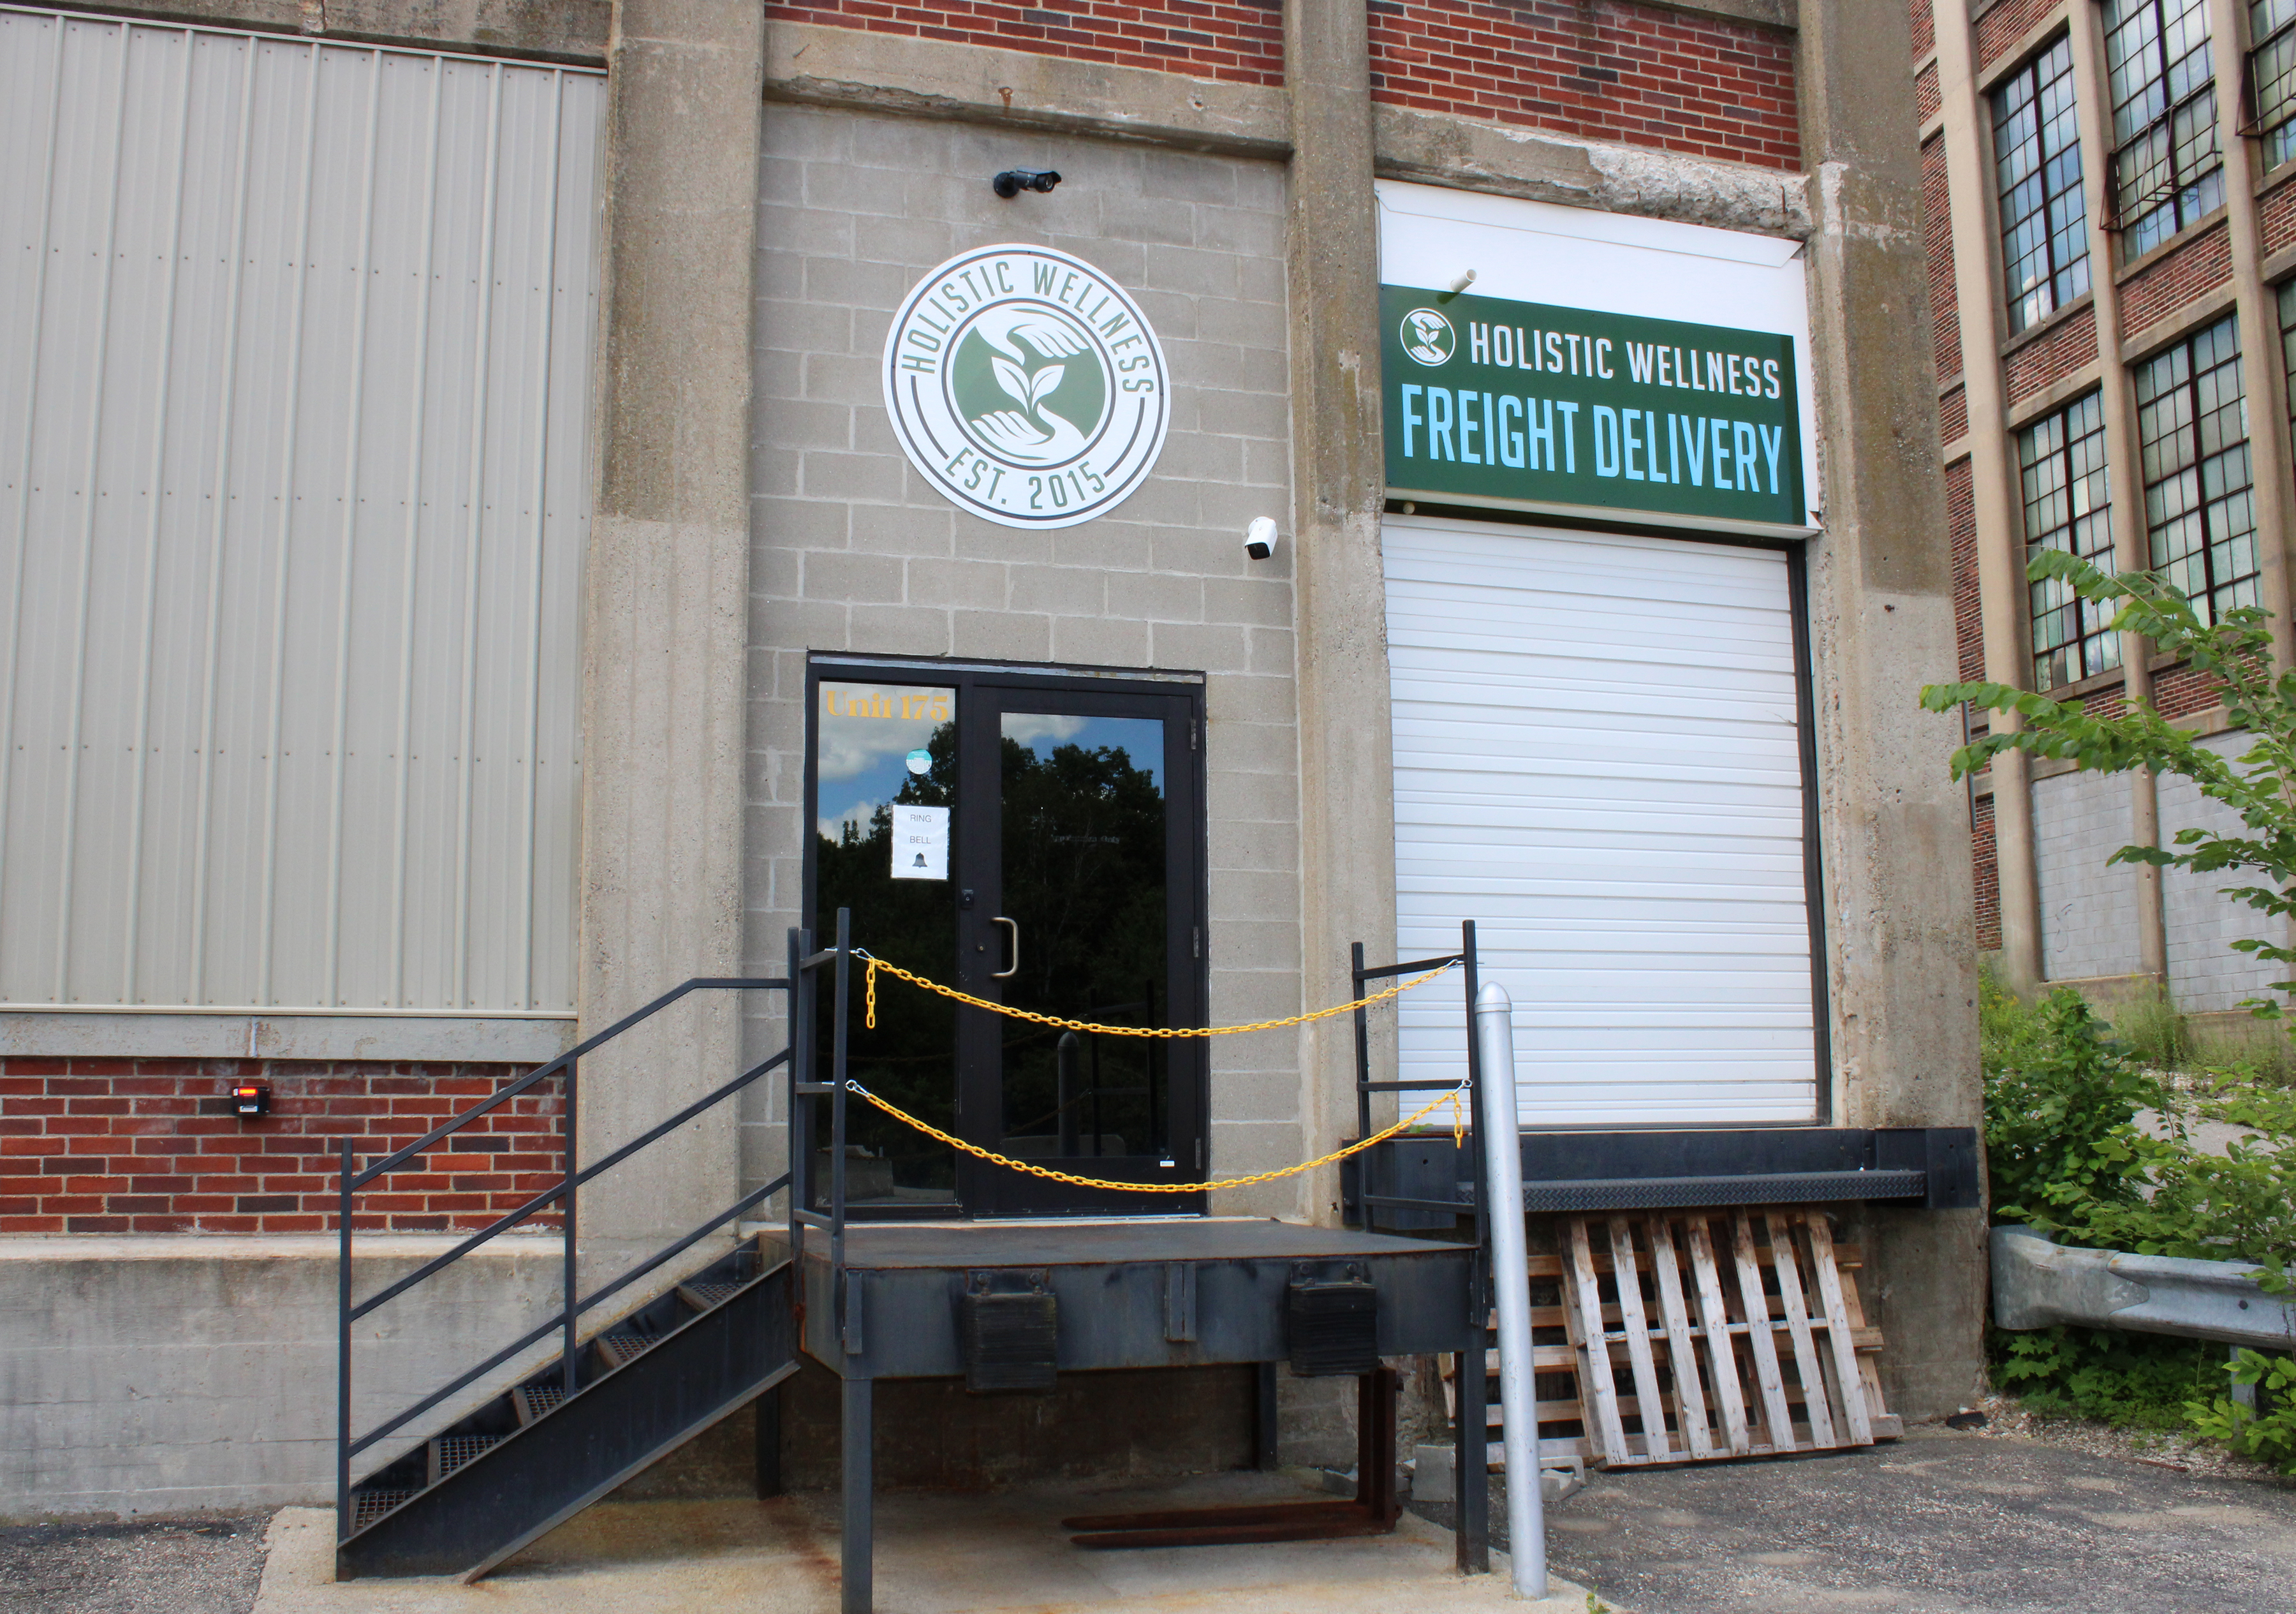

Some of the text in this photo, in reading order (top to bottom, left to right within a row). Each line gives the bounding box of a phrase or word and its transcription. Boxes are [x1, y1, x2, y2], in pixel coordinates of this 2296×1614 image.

[901, 261, 1154, 393] HOLISTIC WELLNESS
[1469, 321, 1781, 400] HOLISTIC WELLNESS
[1401, 383, 1783, 495] FREIGHT DELIVERY
[945, 447, 1105, 510] EST. 2015
[825, 690, 949, 722] Unit 175
[909, 814, 932, 823] RING
[909, 836, 931, 844] BELL
